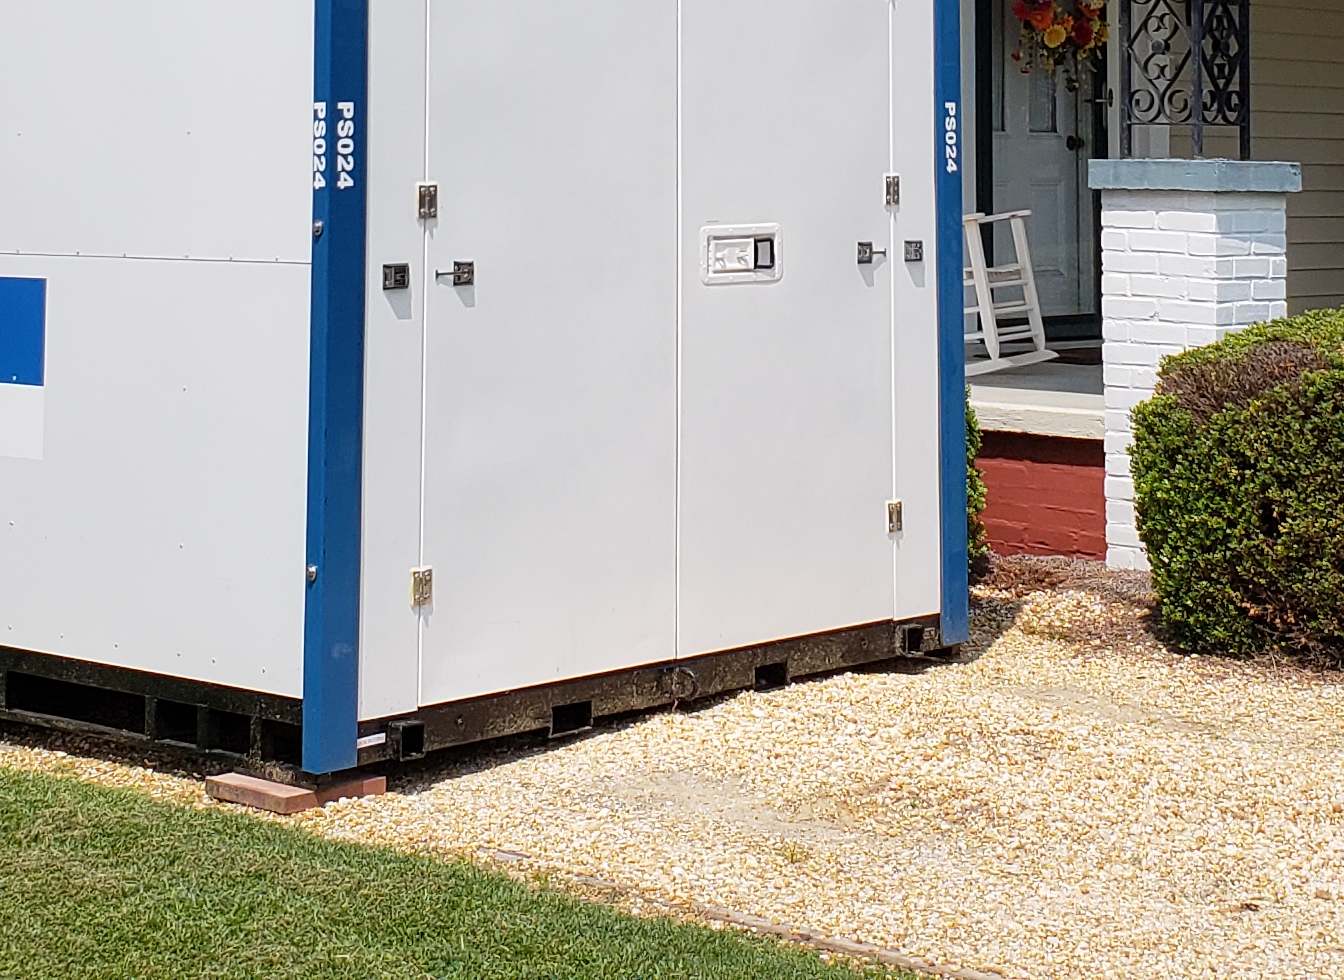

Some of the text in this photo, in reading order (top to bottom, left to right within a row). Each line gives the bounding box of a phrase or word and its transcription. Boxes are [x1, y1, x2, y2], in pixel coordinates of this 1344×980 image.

[313, 101, 326, 190] PS024
[337, 101, 354, 190] PS024
[945, 101, 957, 173] PS024
